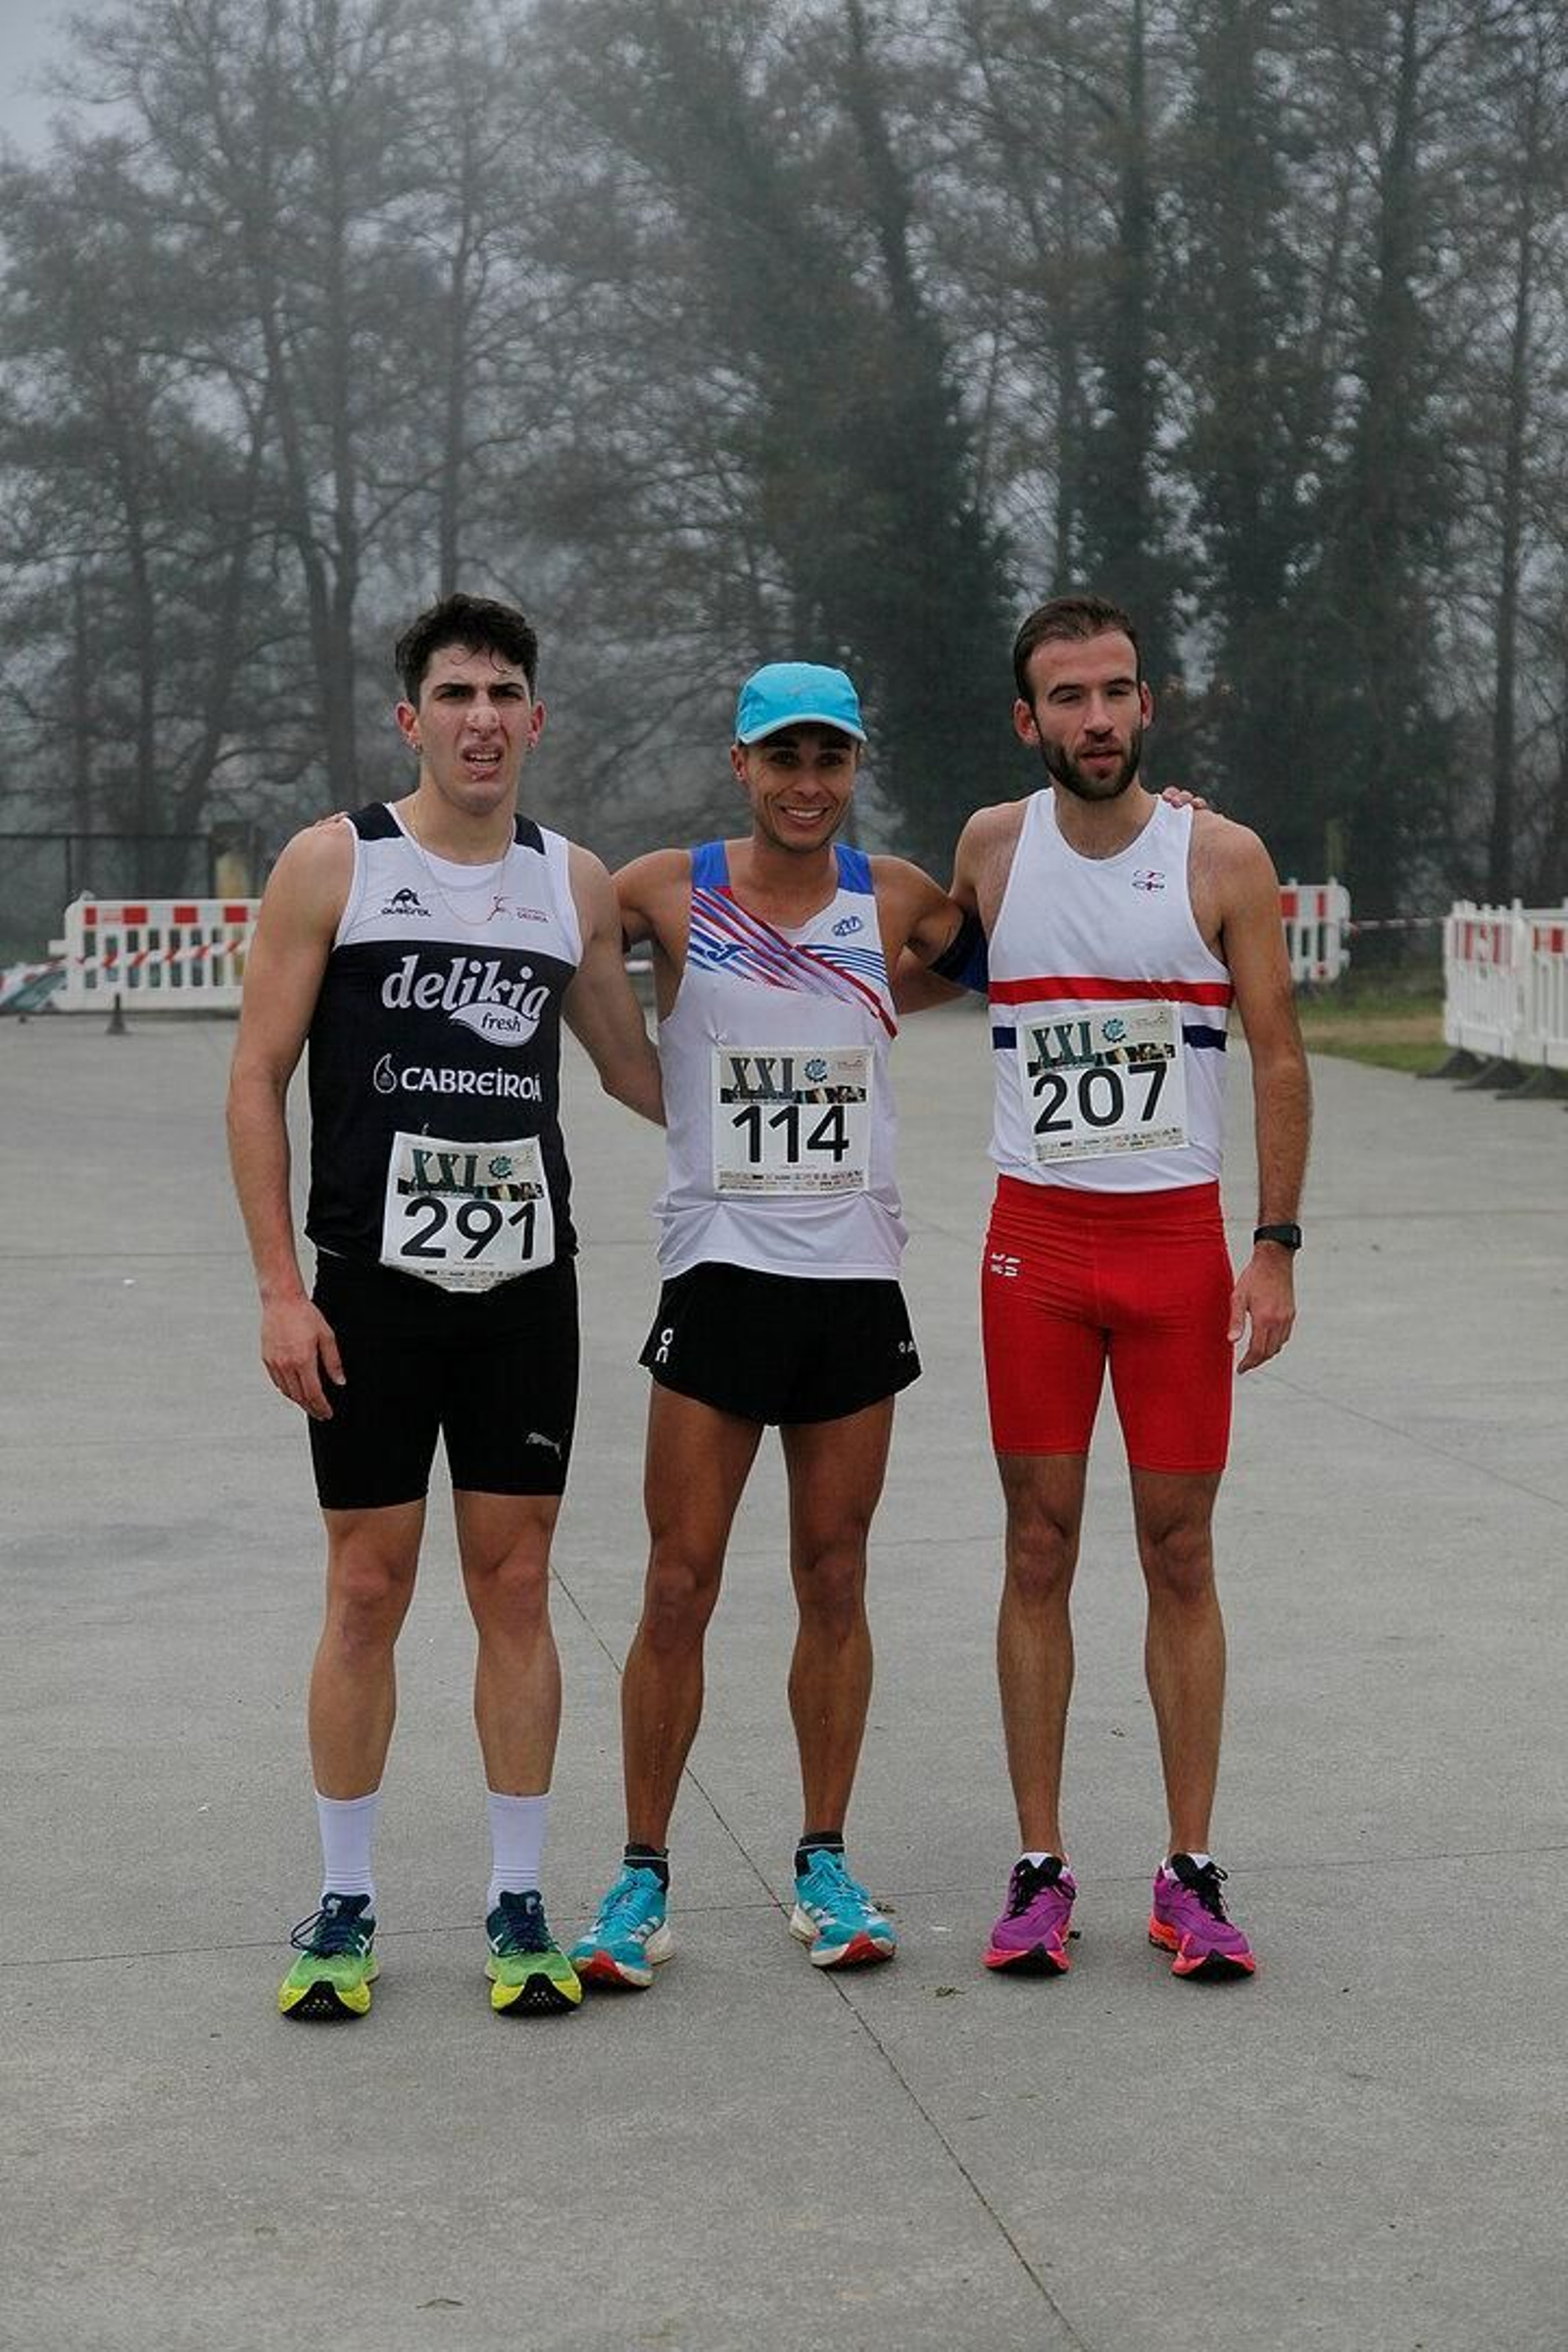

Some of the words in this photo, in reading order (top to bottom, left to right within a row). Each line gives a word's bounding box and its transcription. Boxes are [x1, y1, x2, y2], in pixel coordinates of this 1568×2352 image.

[382, 954, 551, 1020] delikia
[482, 1012, 521, 1032] fresh
[1031, 1021, 1097, 1068] XXI
[728, 1057, 796, 1100] XXI
[1033, 1061, 1166, 1135] 207
[732, 1104, 850, 1163] 114
[411, 1149, 479, 1194] XXI
[400, 1197, 536, 1260] 291
